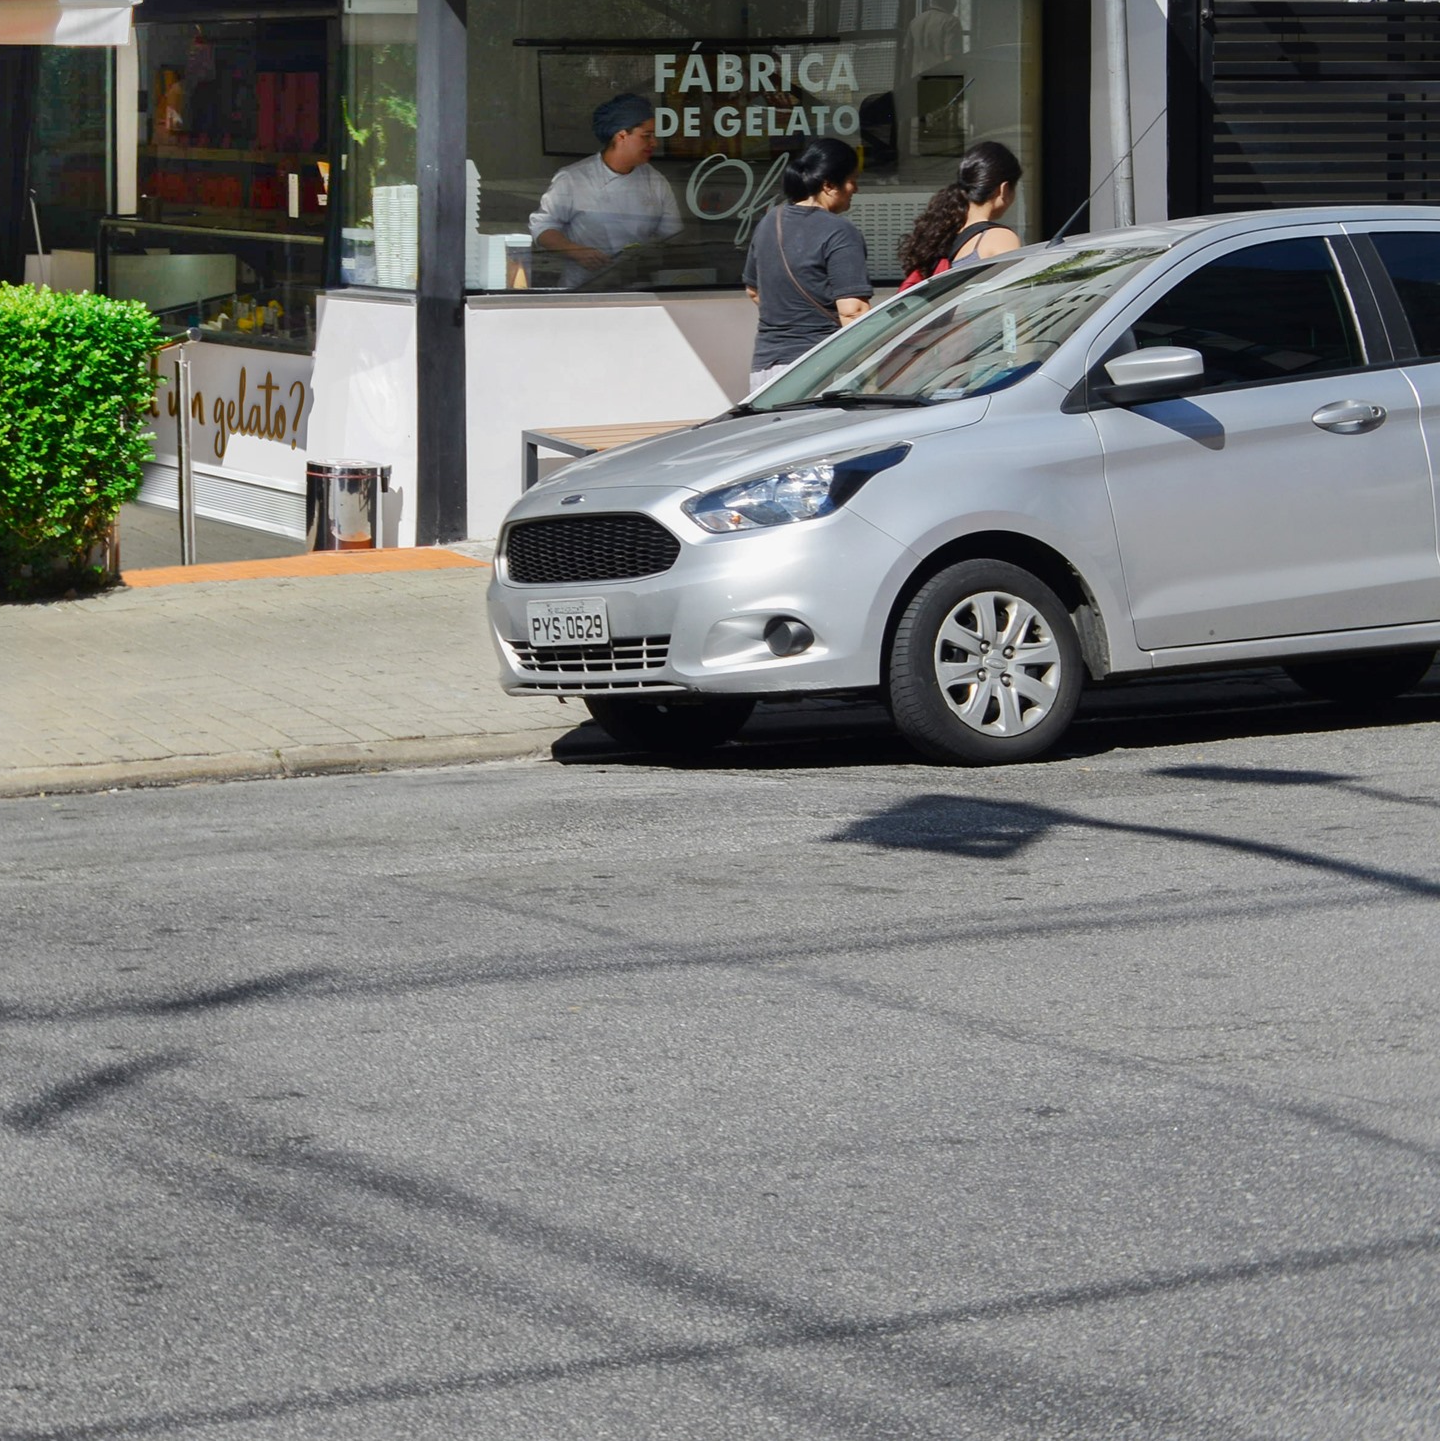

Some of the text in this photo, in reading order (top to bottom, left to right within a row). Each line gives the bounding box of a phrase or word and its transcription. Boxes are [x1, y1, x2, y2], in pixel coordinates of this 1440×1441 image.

[655, 42, 860, 93] FÁBRICA
[655, 105, 861, 137] DE GELATO
[213, 365, 305, 460] gelato?
